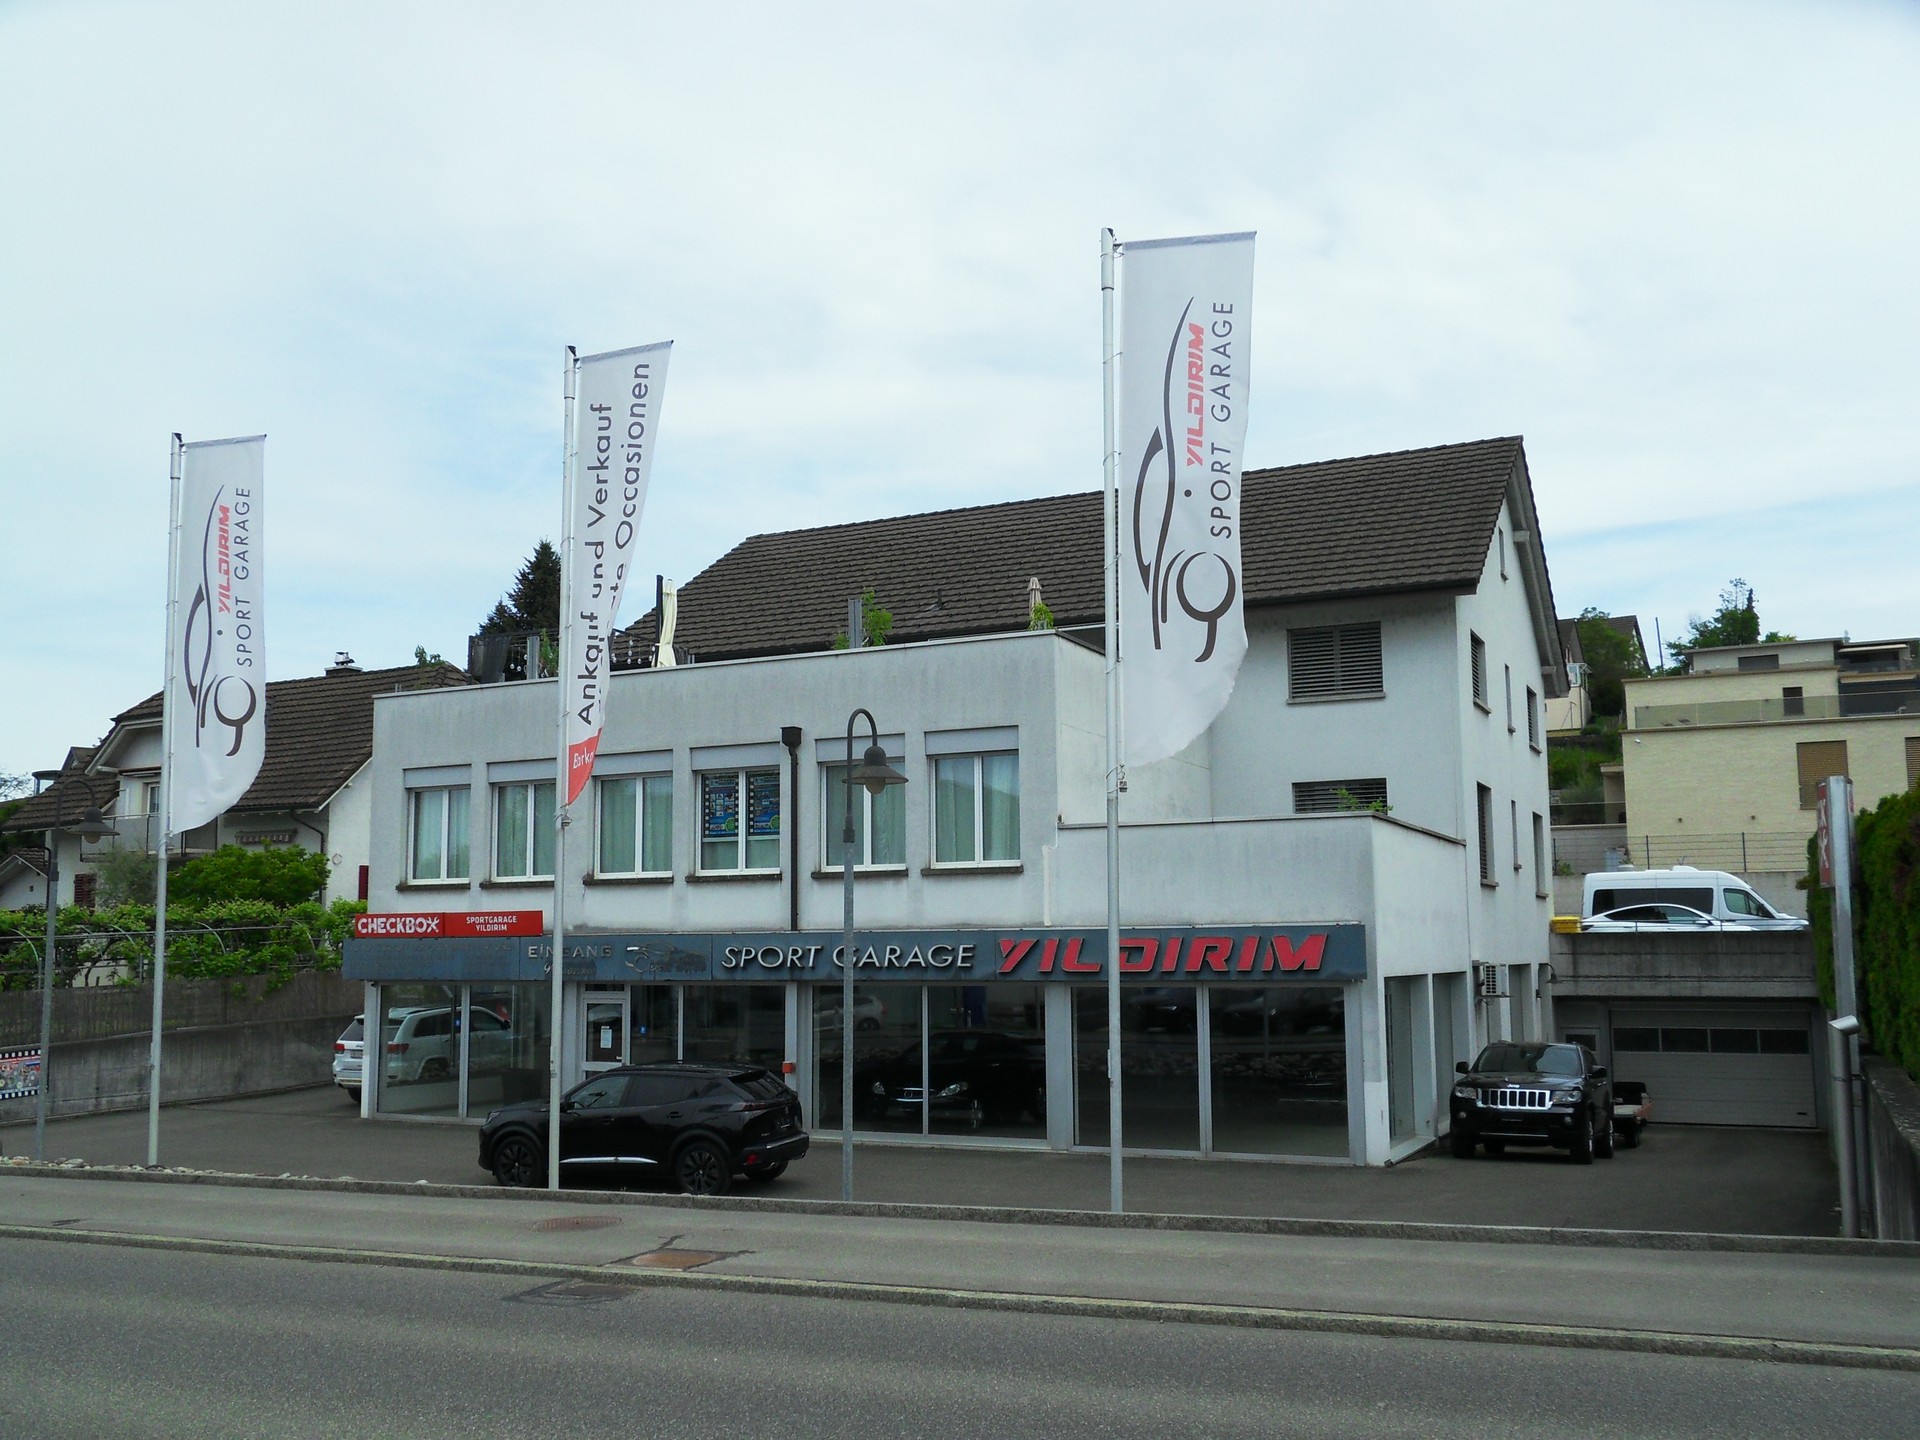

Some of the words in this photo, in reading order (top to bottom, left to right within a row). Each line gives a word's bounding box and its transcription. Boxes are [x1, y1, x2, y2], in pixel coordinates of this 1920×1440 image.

[1186, 322, 1204, 467] YILDIRIM
[1209, 302, 1233, 423] GARAGE
[587, 403, 612, 528] Verkauf
[615, 363, 650, 550] Occasionen
[1210, 442, 1232, 540] SPORT
[218, 504, 231, 614] YILDIRIM
[233, 487, 251, 581] GARAGE
[584, 541, 604, 599] und
[235, 596, 253, 668] SPORT
[357, 915, 440, 934] CHECKBOX
[466, 915, 518, 924] SPORTGARAGE
[475, 923, 507, 932] YILDIRIM
[721, 945, 822, 969] SPORT
[833, 944, 974, 969] GARAGE
[998, 933, 1328, 973] YILDIRIM
